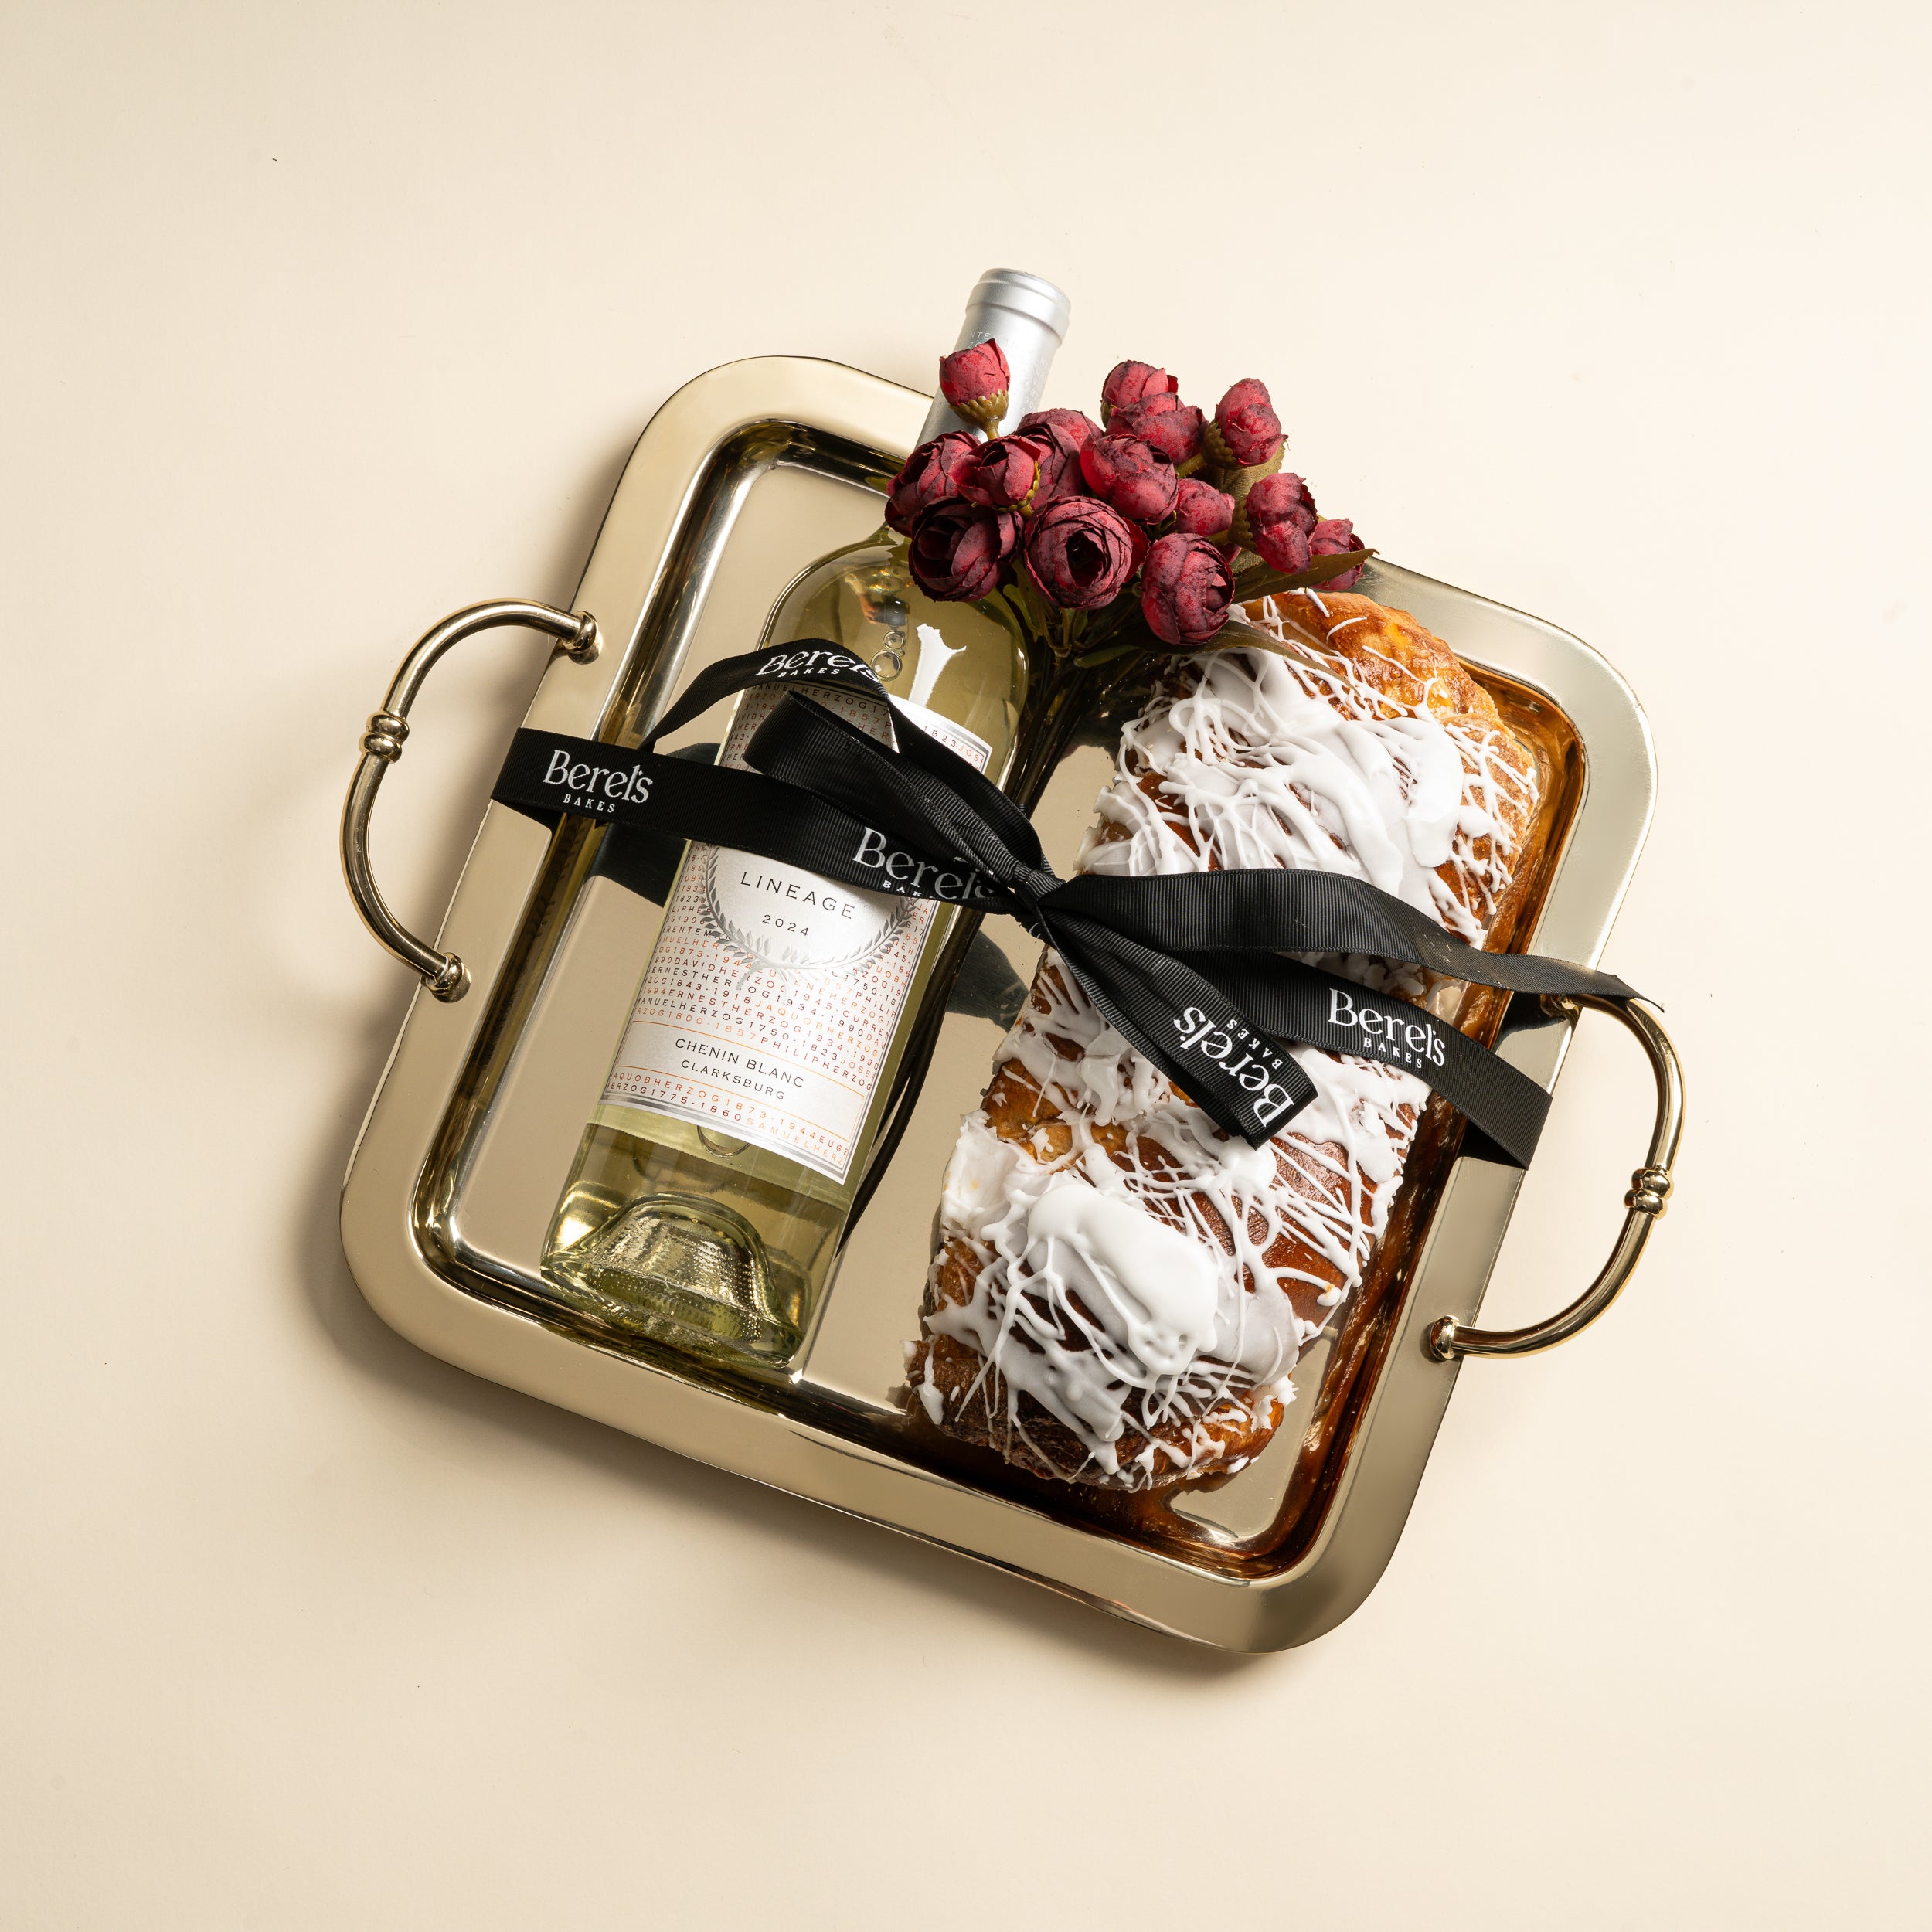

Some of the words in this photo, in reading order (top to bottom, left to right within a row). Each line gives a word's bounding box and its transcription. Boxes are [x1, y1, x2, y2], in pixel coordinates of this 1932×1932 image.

[542, 749, 653, 803] Berel's
[563, 794, 615, 813] BAKES
[740, 872, 855, 919] LINEAGE
[762, 915, 809, 936] 2024
[1226, 1019, 1283, 1070] BAKES
[1328, 988, 1445, 1066] Berel's
[675, 1038, 740, 1064] CHENIN
[746, 1059, 804, 1087] BLANC
[1173, 1006, 1294, 1128] Berel's
[1363, 1038, 1422, 1069] BAKES
[682, 1060, 785, 1100] CLARKSBURG
